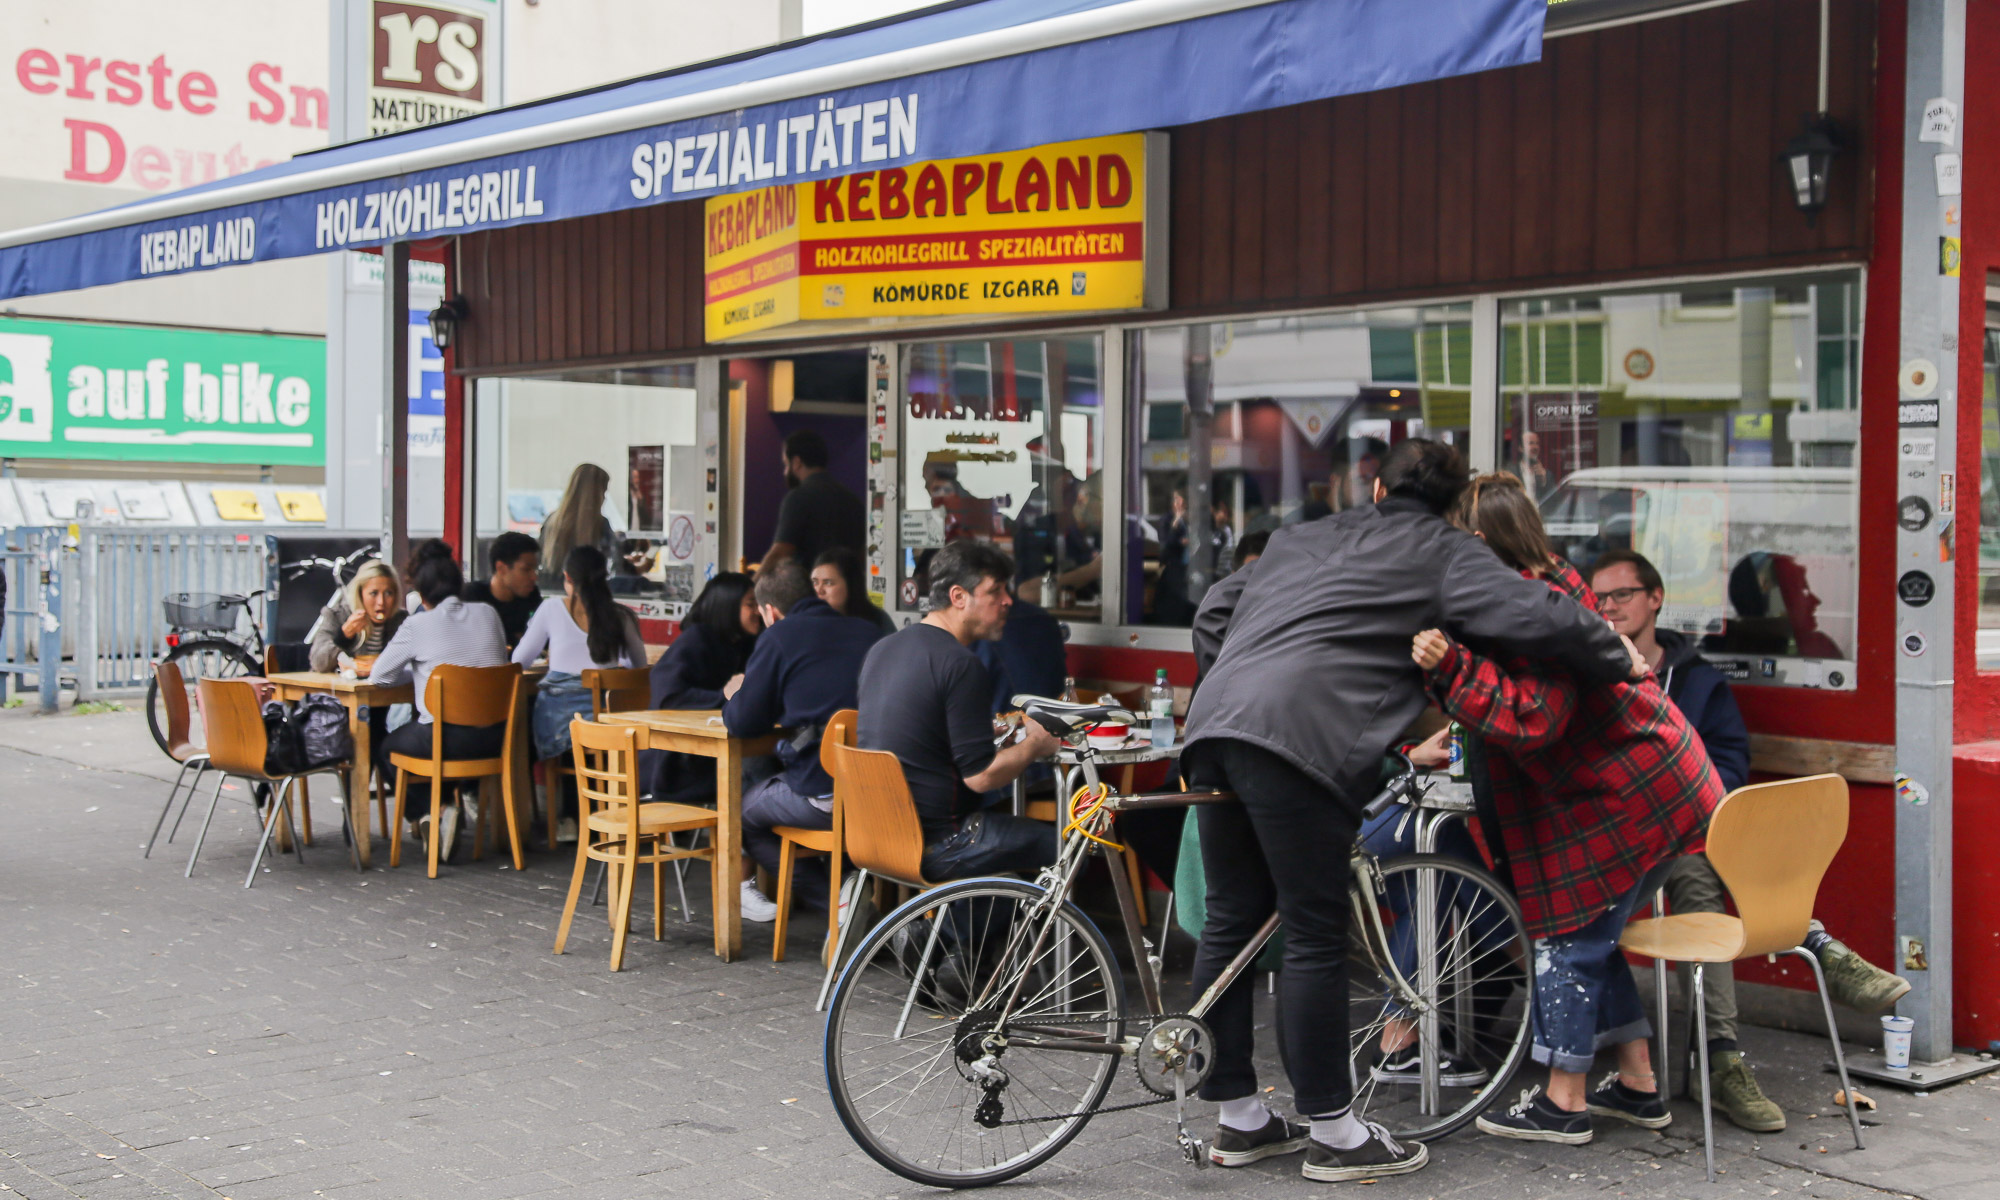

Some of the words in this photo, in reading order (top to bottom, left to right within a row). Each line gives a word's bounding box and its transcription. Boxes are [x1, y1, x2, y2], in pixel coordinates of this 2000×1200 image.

[16, 48, 218, 115] erste
[378, 12, 479, 92] rs
[629, 93, 919, 199] SPEZIALITÄTEN
[315, 165, 544, 249] HOLZKOHLEGRILL
[708, 183, 797, 258] KEBAPLAND
[813, 152, 1133, 223] KEBAPLAND
[141, 216, 256, 275] KEBAPLAND
[815, 239, 970, 268] HOLZKOHLEGRILL
[979, 230, 1125, 260] SPEZIALITÄTEN
[873, 280, 970, 303] KÖMÜRDE
[983, 278, 1060, 299] IZGARA
[67, 358, 169, 420] auf
[183, 361, 312, 426] bike
[1537, 405, 1569, 417] OPEN
